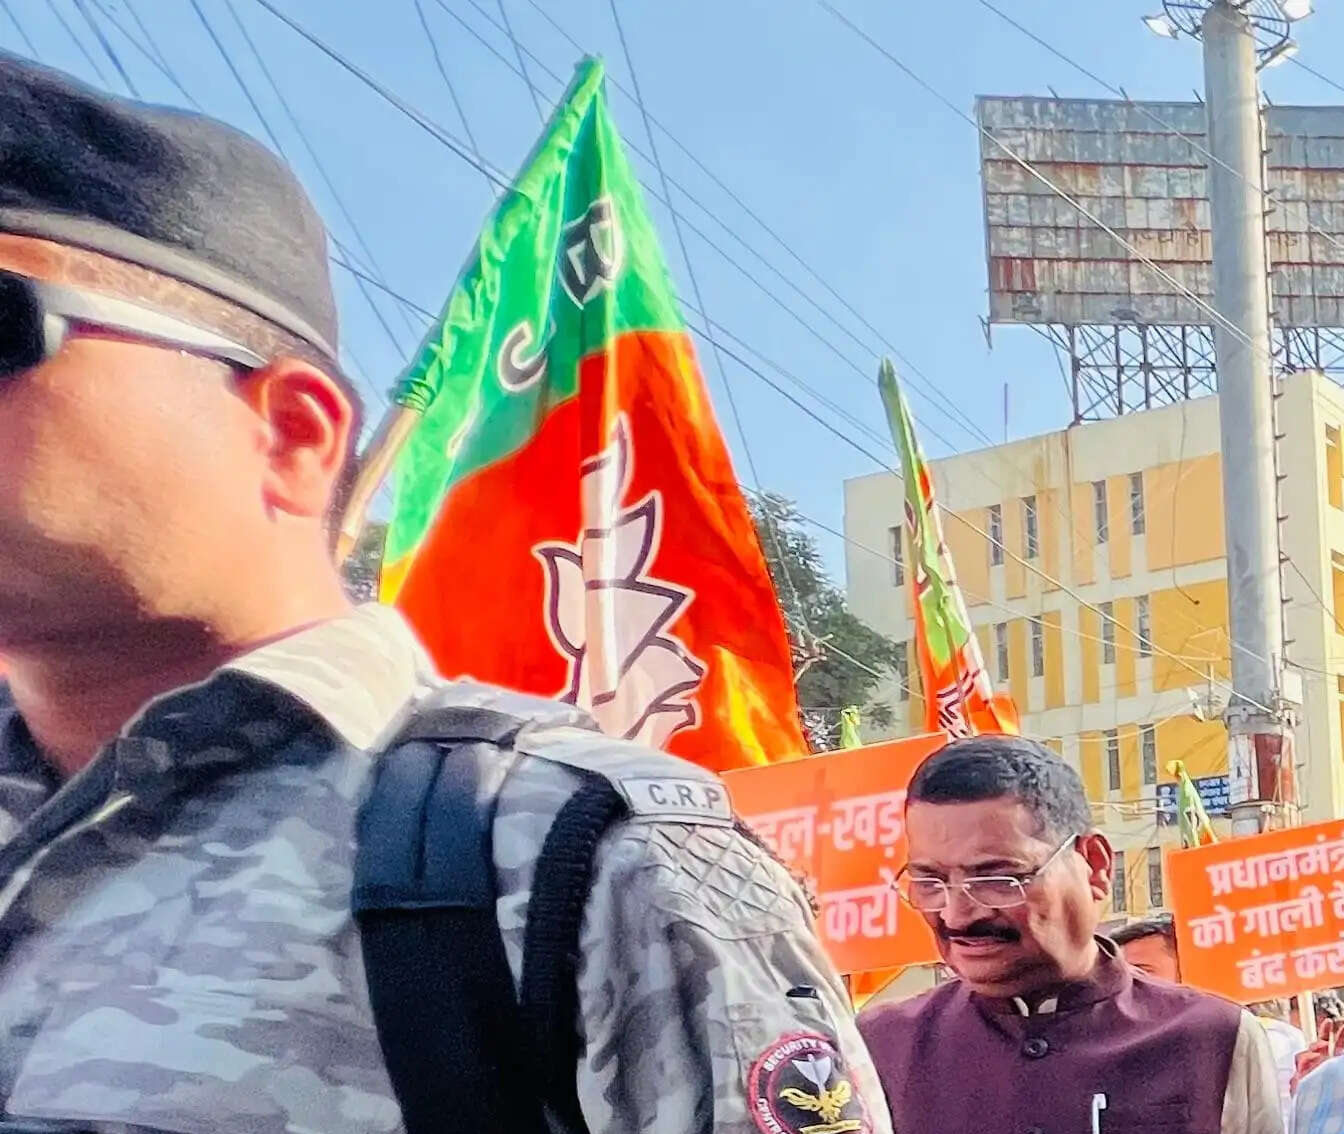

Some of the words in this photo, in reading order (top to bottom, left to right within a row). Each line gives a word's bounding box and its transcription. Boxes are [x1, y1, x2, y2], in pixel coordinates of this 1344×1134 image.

[820, 867, 900, 943] करो
[1187, 905, 1236, 948] को
[1239, 884, 1324, 937] गाली
[1235, 949, 1288, 989] बंद
